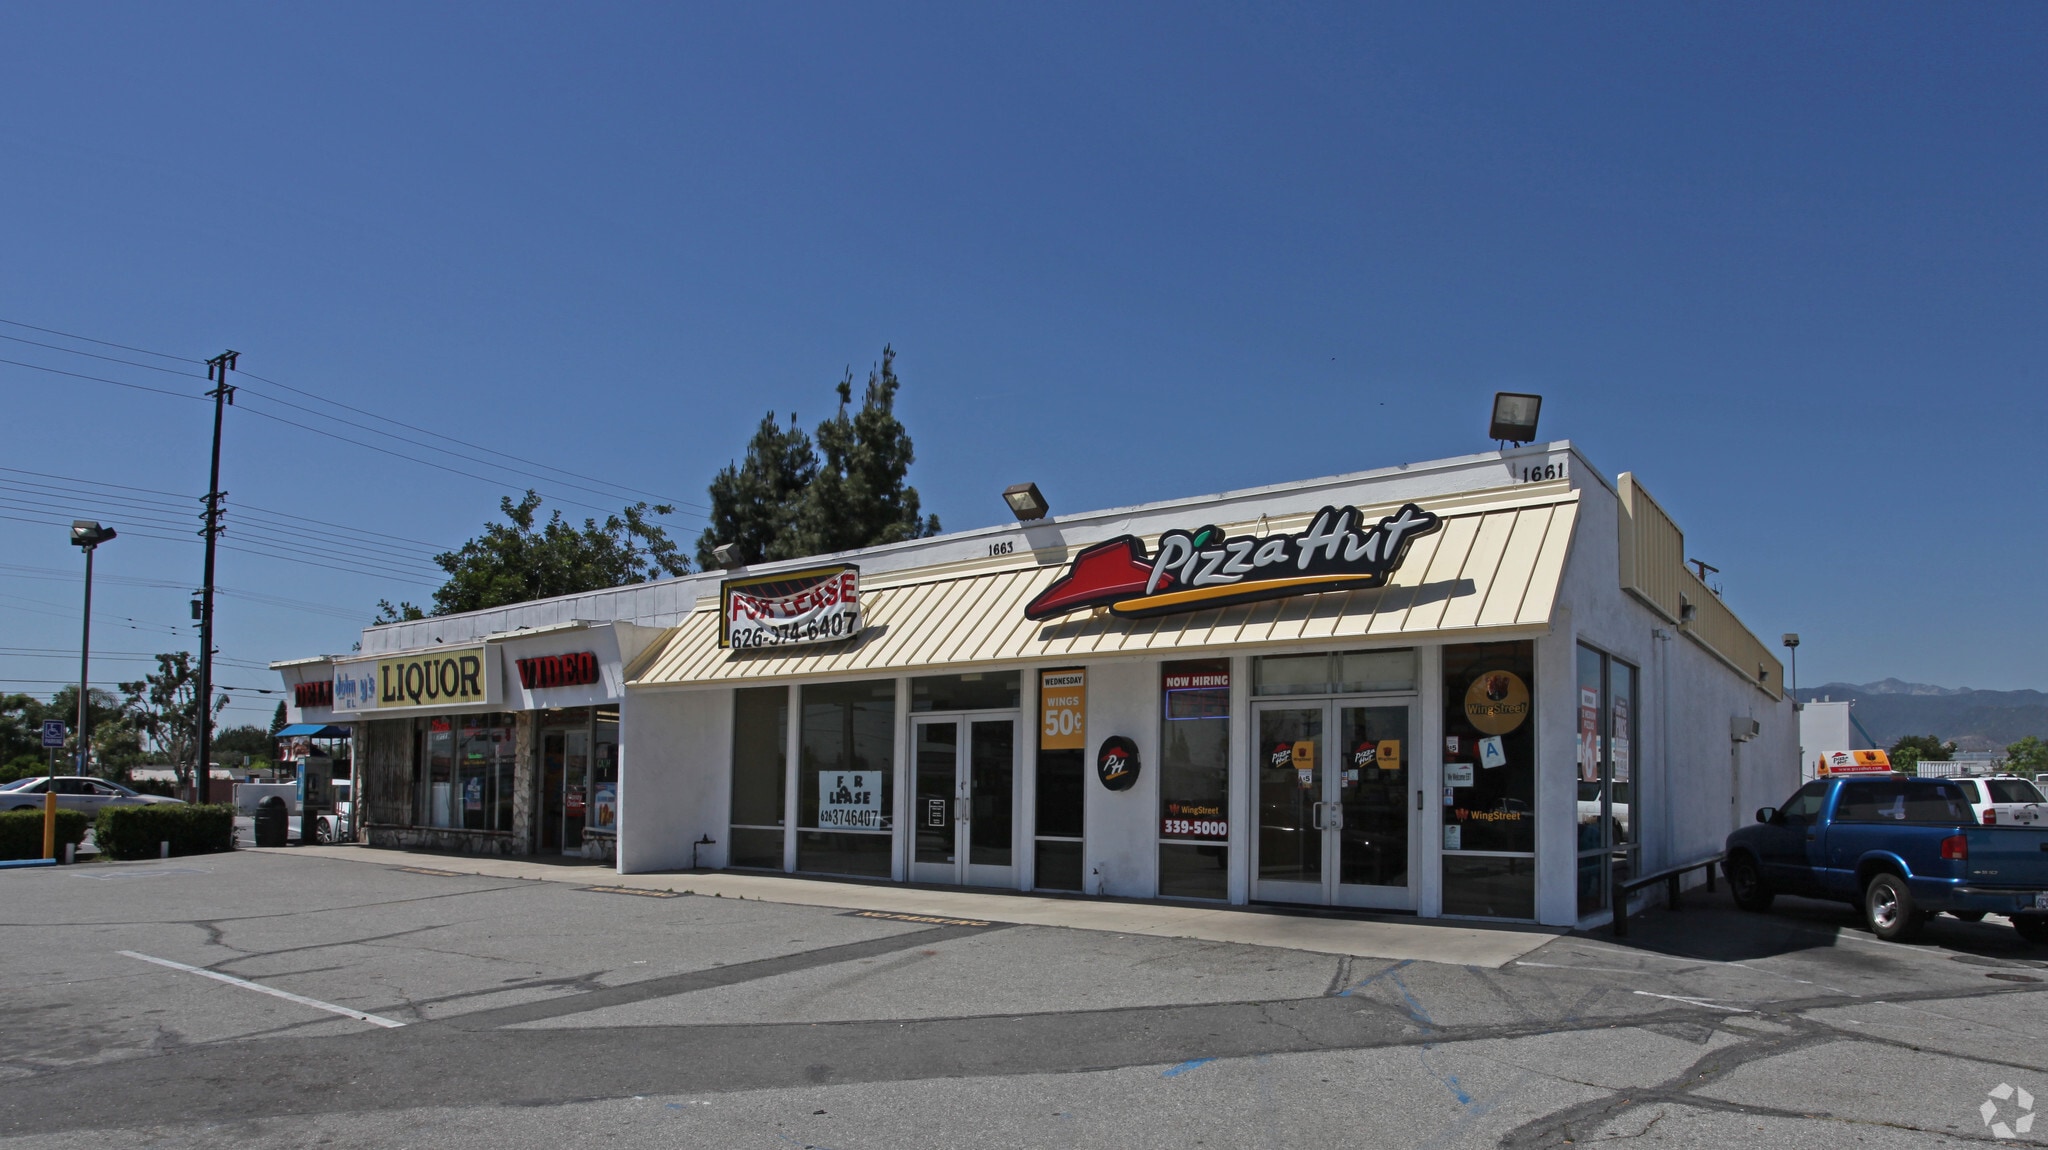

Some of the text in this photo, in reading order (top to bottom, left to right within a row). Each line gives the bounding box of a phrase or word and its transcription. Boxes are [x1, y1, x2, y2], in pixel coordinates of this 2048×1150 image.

[1523, 462, 1563, 483] 1661
[989, 541, 1013, 556] 1663
[1146, 509, 1429, 595] Pizza Hut
[733, 574, 857, 621] FOR LEASE
[732, 612, 858, 648] 626-374-6407
[516, 651, 599, 689] VIDEO
[382, 655, 481, 705] LIQUOR
[1045, 676, 1082, 686] WEDNESDAY
[1166, 675, 1228, 687] NOW HIRING
[294, 680, 333, 707] DELI
[1047, 697, 1079, 706] WINGS
[1468, 703, 1527, 718] WingStreet
[1045, 709, 1082, 736] 50¢
[1272, 749, 1291, 763] Pizza
[1355, 749, 1376, 763] Pizza
[1487, 743, 1499, 758] A
[1275, 755, 1289, 765] Hut
[1359, 755, 1373, 766] Hut
[820, 809, 878, 827] 626 3746407
[1181, 806, 1219, 815] WingStreet
[1471, 810, 1521, 822] WingStreet
[1165, 820, 1227, 835] 339-5000
